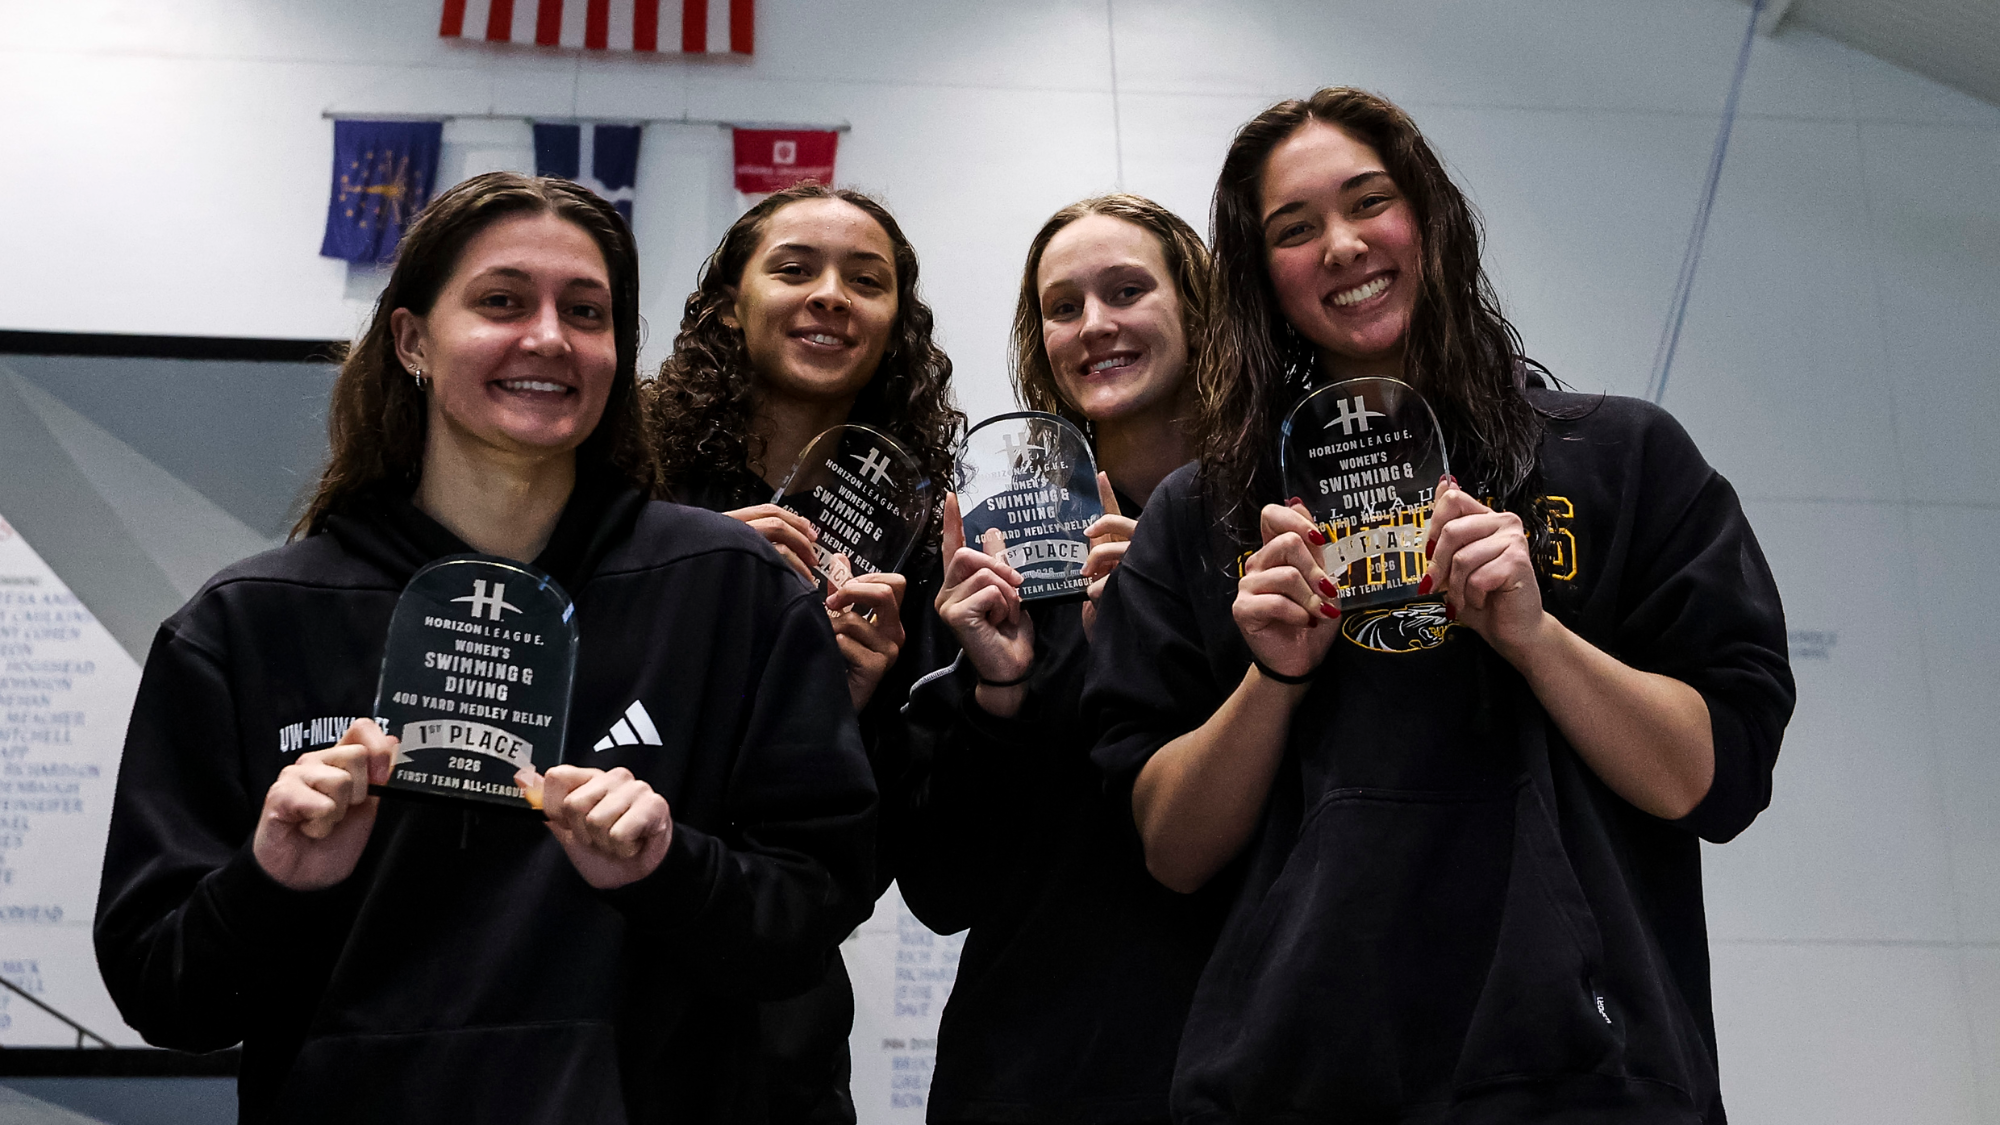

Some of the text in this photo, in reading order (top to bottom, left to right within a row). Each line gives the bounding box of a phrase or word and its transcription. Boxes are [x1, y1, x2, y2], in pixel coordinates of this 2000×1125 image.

[1308, 440, 1358, 459] HORIZON
[1339, 451, 1388, 471] WOMEN'S
[825, 458, 863, 490] HORIZON
[1005, 478, 1049, 492] WOMEN'S
[1319, 462, 1414, 495] SWIMMING &
[838, 484, 875, 516] WOMEN'S
[986, 487, 1070, 511] SWIMMING &
[1343, 485, 1398, 510] DIVING
[813, 485, 883, 542] SWIMMING &
[1007, 506, 1056, 524] DIVING
[819, 508, 861, 545] DIVING
[995, 529, 1021, 541] YARD
[1023, 523, 1060, 537] MEDLEY
[821, 531, 855, 558] MEDLEY
[1023, 543, 1080, 561] PLACE
[1369, 560, 1396, 575] 2026
[1022, 584, 1044, 595] TEAM
[1046, 576, 1094, 591] ALL-LEAGUE
[1336, 586, 1356, 599] IRST
[1359, 581, 1384, 595] TEAM
[424, 616, 482, 635] HORIZON
[455, 639, 511, 660] WOMEN'S
[424, 651, 533, 686] SWIMMING &
[444, 676, 509, 702] DIVING
[392, 691, 553, 728] 400 YARD MEDLEY RELAY
[450, 725, 523, 759] PLACE
[396, 769, 526, 798] FIRST TEAM ALL-LEAGUE
